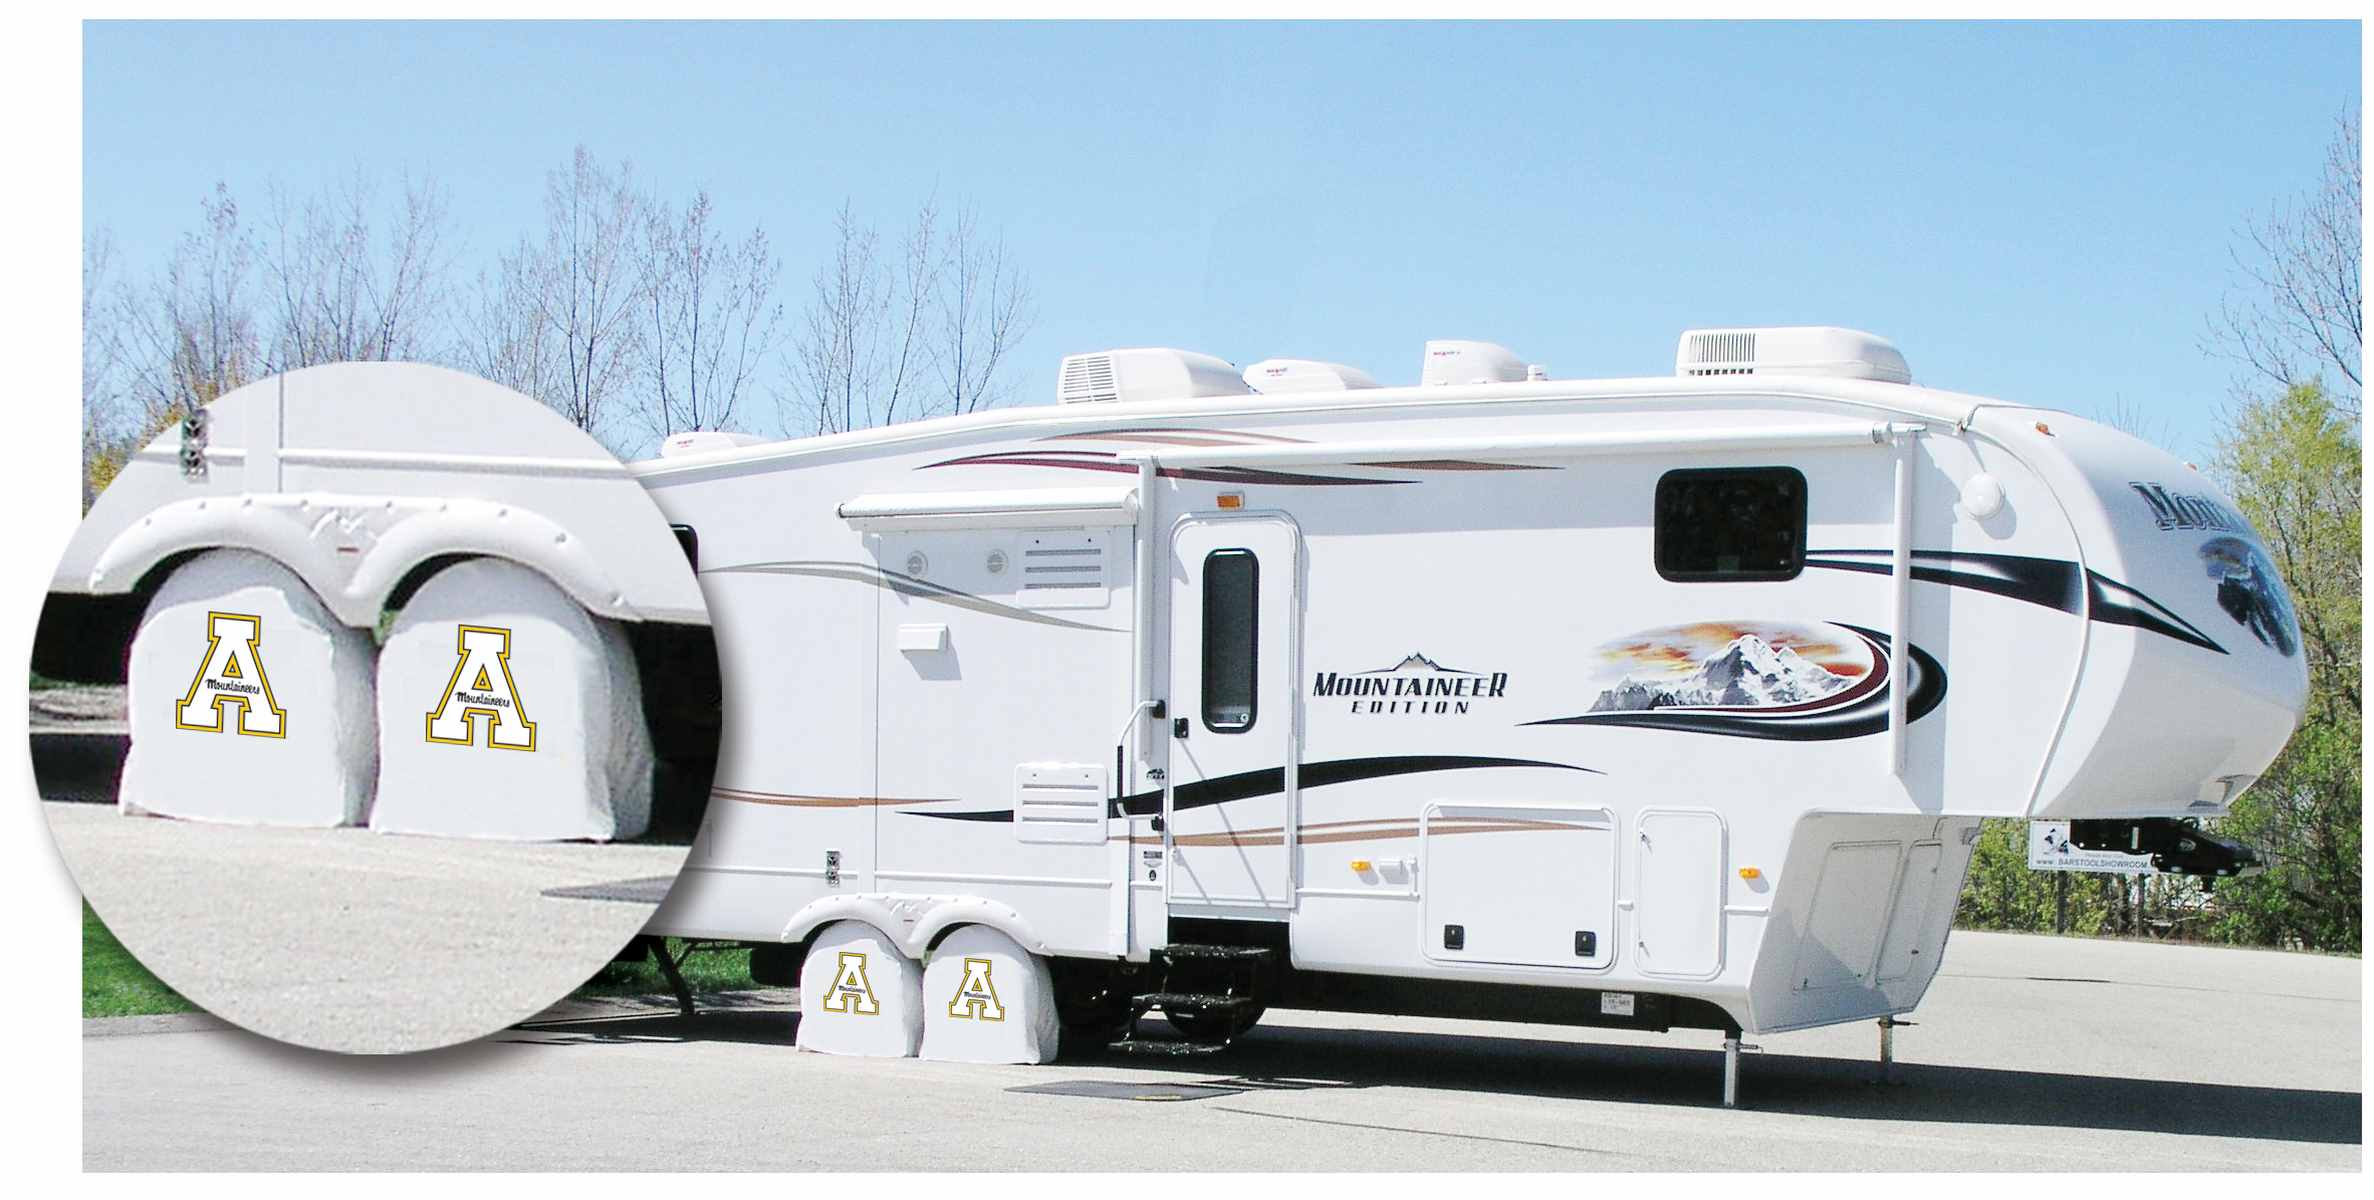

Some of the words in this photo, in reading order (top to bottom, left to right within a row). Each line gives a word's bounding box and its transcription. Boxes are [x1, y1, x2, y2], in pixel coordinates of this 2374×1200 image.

[175, 611, 287, 739] A
[205, 678, 260, 695] Mountaineers
[425, 624, 537, 752] A
[1313, 672, 1508, 697] MOUNTAINEER
[455, 692, 510, 708] Mountaineers
[1351, 700, 1469, 714] EDITION
[823, 951, 880, 1016] A
[948, 957, 1005, 1022] A
